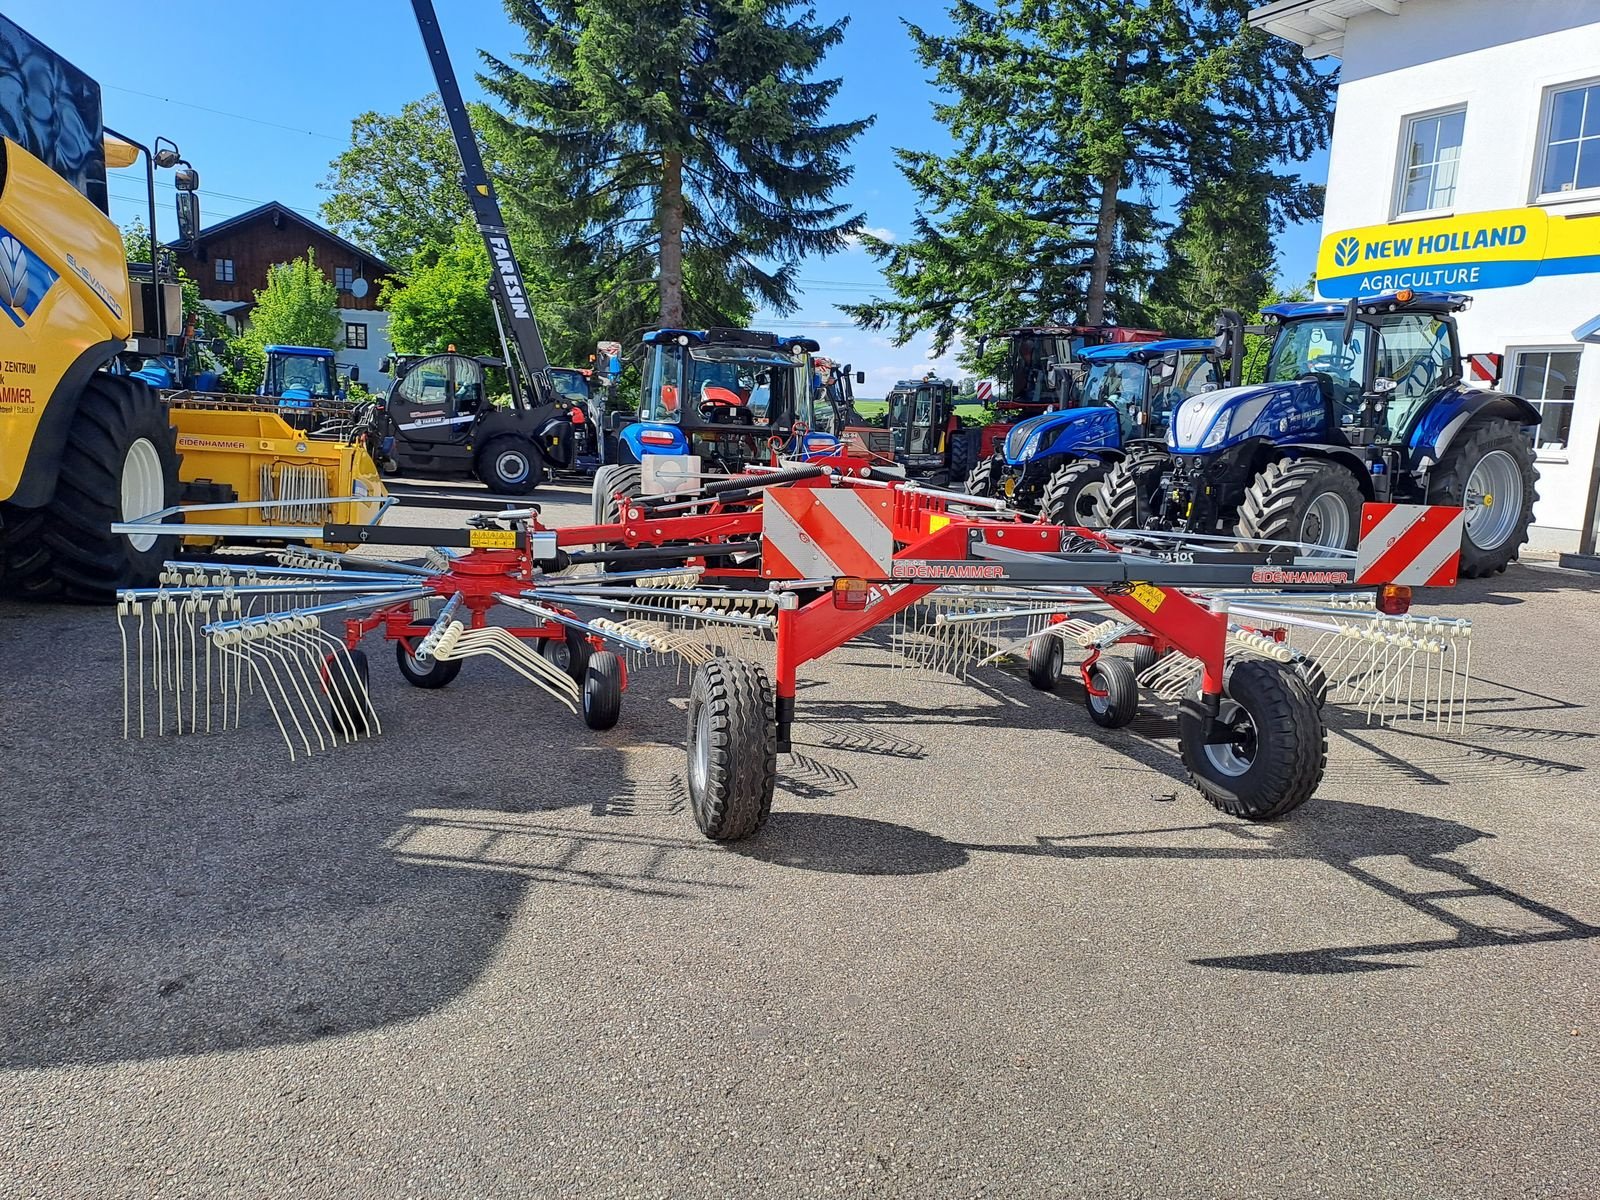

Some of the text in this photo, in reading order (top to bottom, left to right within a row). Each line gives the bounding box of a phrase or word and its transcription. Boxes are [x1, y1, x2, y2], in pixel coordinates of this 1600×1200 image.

[1364, 224, 1527, 260] NEW HOLLAND
[489, 237, 530, 319] FARESIN
[1359, 267, 1481, 292] AGRICULTURE
[4, 361, 37, 374] ZENTRUM
[178, 438, 245, 449] EIDENHAMMER
[893, 565, 1004, 578] EIDENHAMMER
[1251, 571, 1348, 584] EIDENHAMMER
